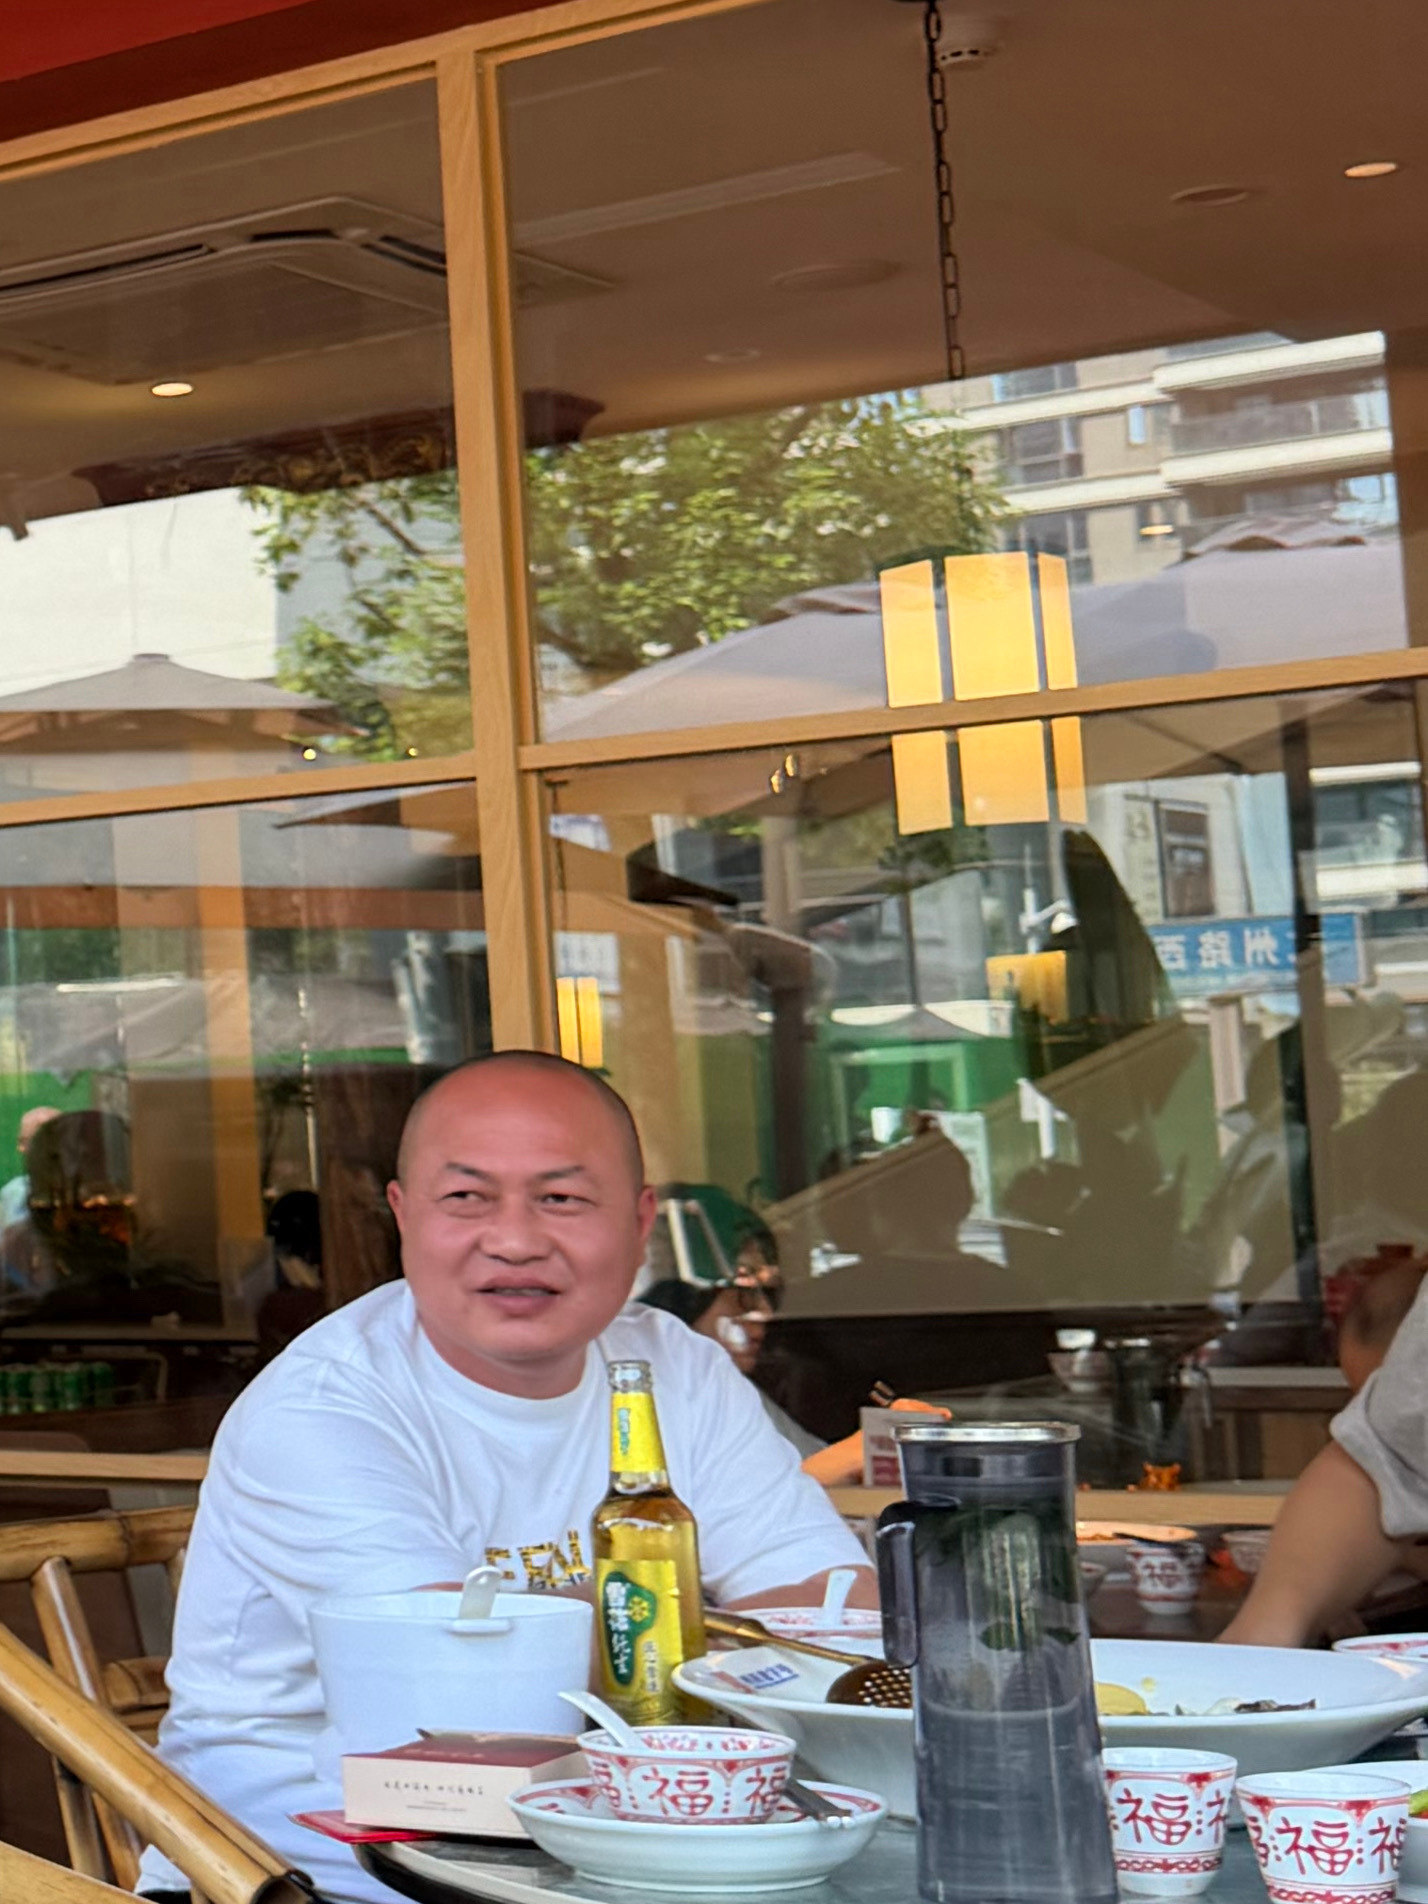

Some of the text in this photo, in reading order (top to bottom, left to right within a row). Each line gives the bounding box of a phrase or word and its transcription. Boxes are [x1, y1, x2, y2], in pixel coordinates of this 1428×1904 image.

[642, 1764, 714, 1817] 福
[1116, 1788, 1193, 1846] 福
[1274, 1816, 1354, 1876] 福
